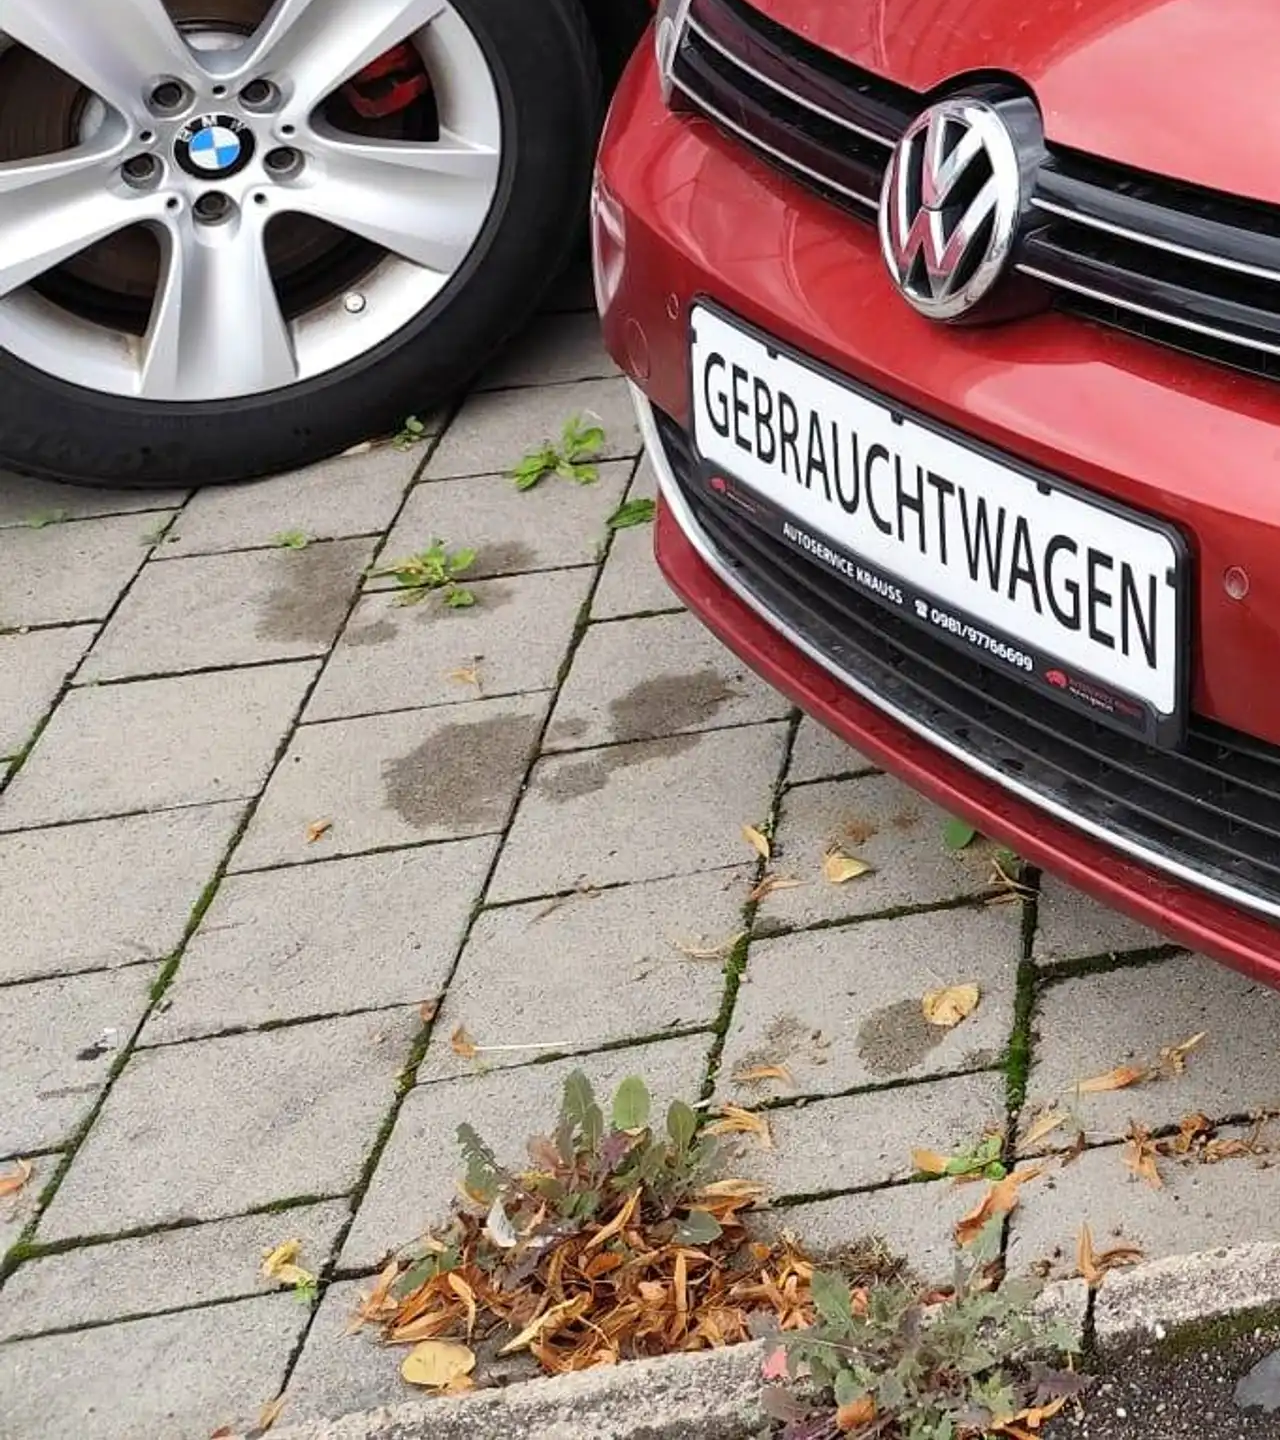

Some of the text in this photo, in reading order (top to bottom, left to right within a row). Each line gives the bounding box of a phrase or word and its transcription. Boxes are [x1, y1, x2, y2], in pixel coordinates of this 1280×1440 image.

[882, 102, 1014, 312] VW
[704, 352, 1159, 669] GEBRAUCHTWAGEN
[783, 522, 855, 578] AUTOSERVICE
[856, 566, 903, 605] KRAUSS
